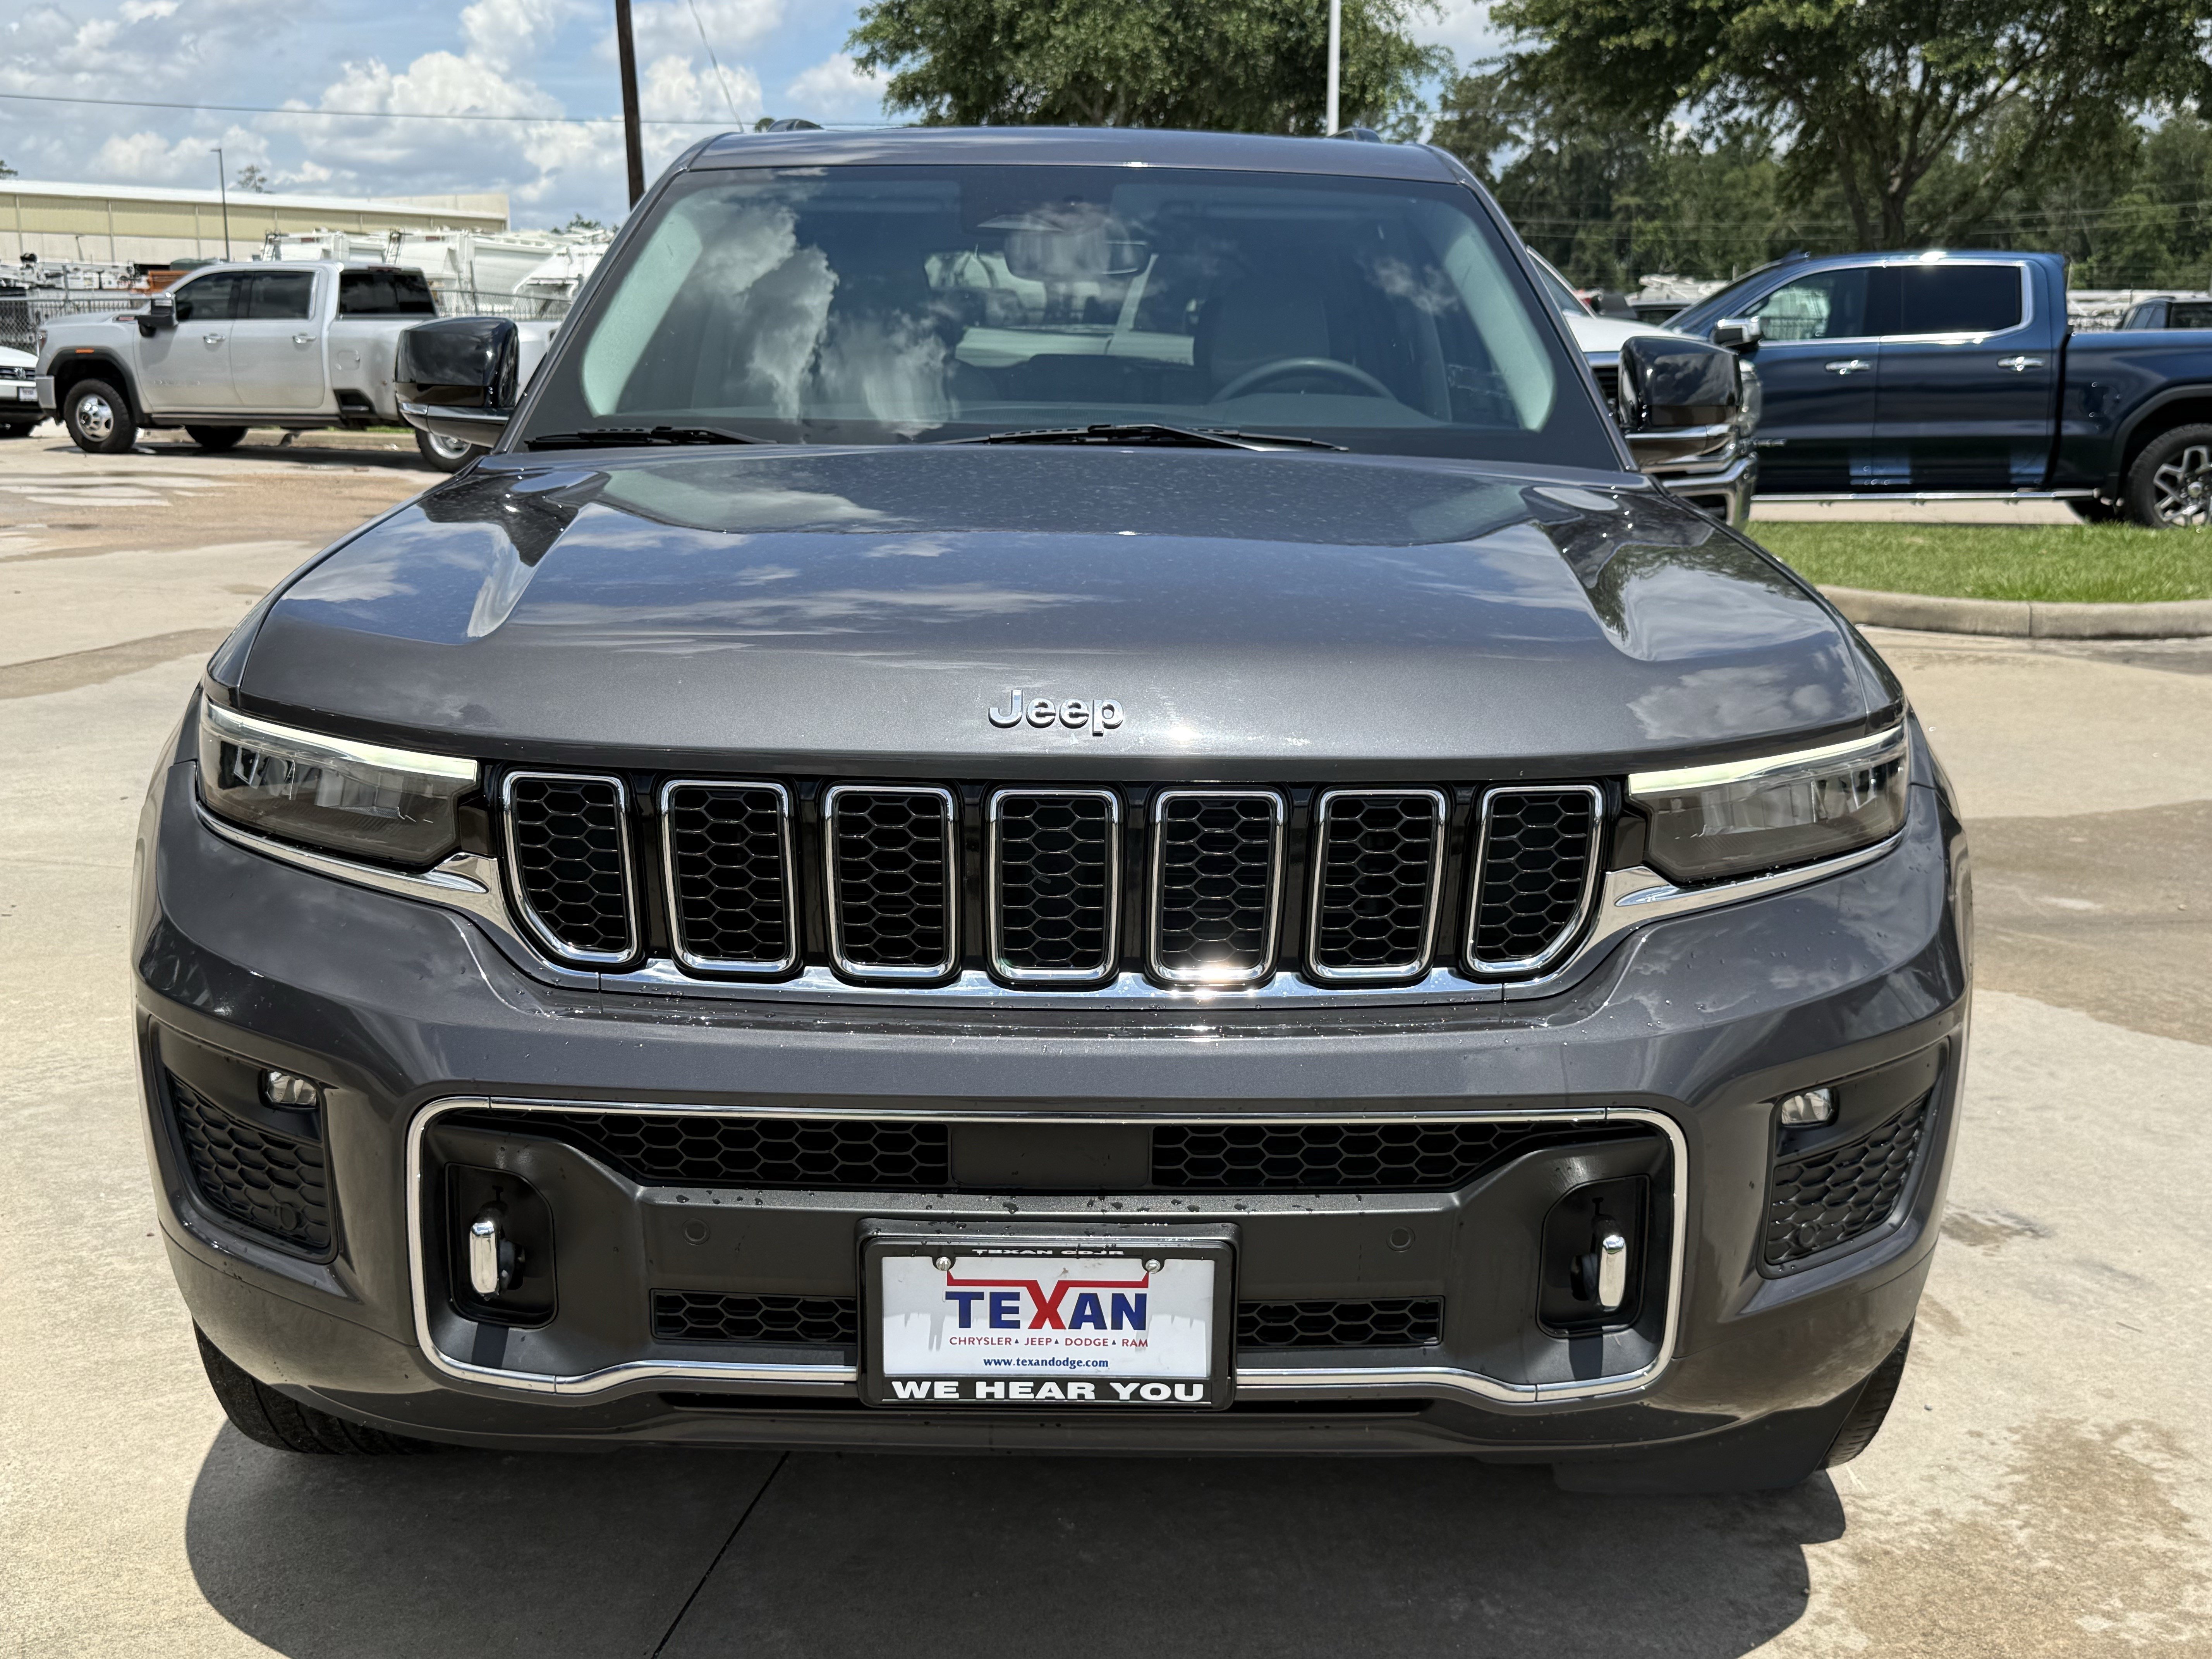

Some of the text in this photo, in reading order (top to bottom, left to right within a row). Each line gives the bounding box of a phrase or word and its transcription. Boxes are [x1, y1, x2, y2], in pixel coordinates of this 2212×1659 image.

[988, 689, 1124, 737] Jeep
[945, 1279, 1147, 1330] TEXAN
[949, 1337, 1148, 1347] CHRYSLER JEEP DODGE RAM
[983, 1357, 1109, 1369] www.texandodge.com
[891, 1381, 1204, 1401] WE HEAR YOU
